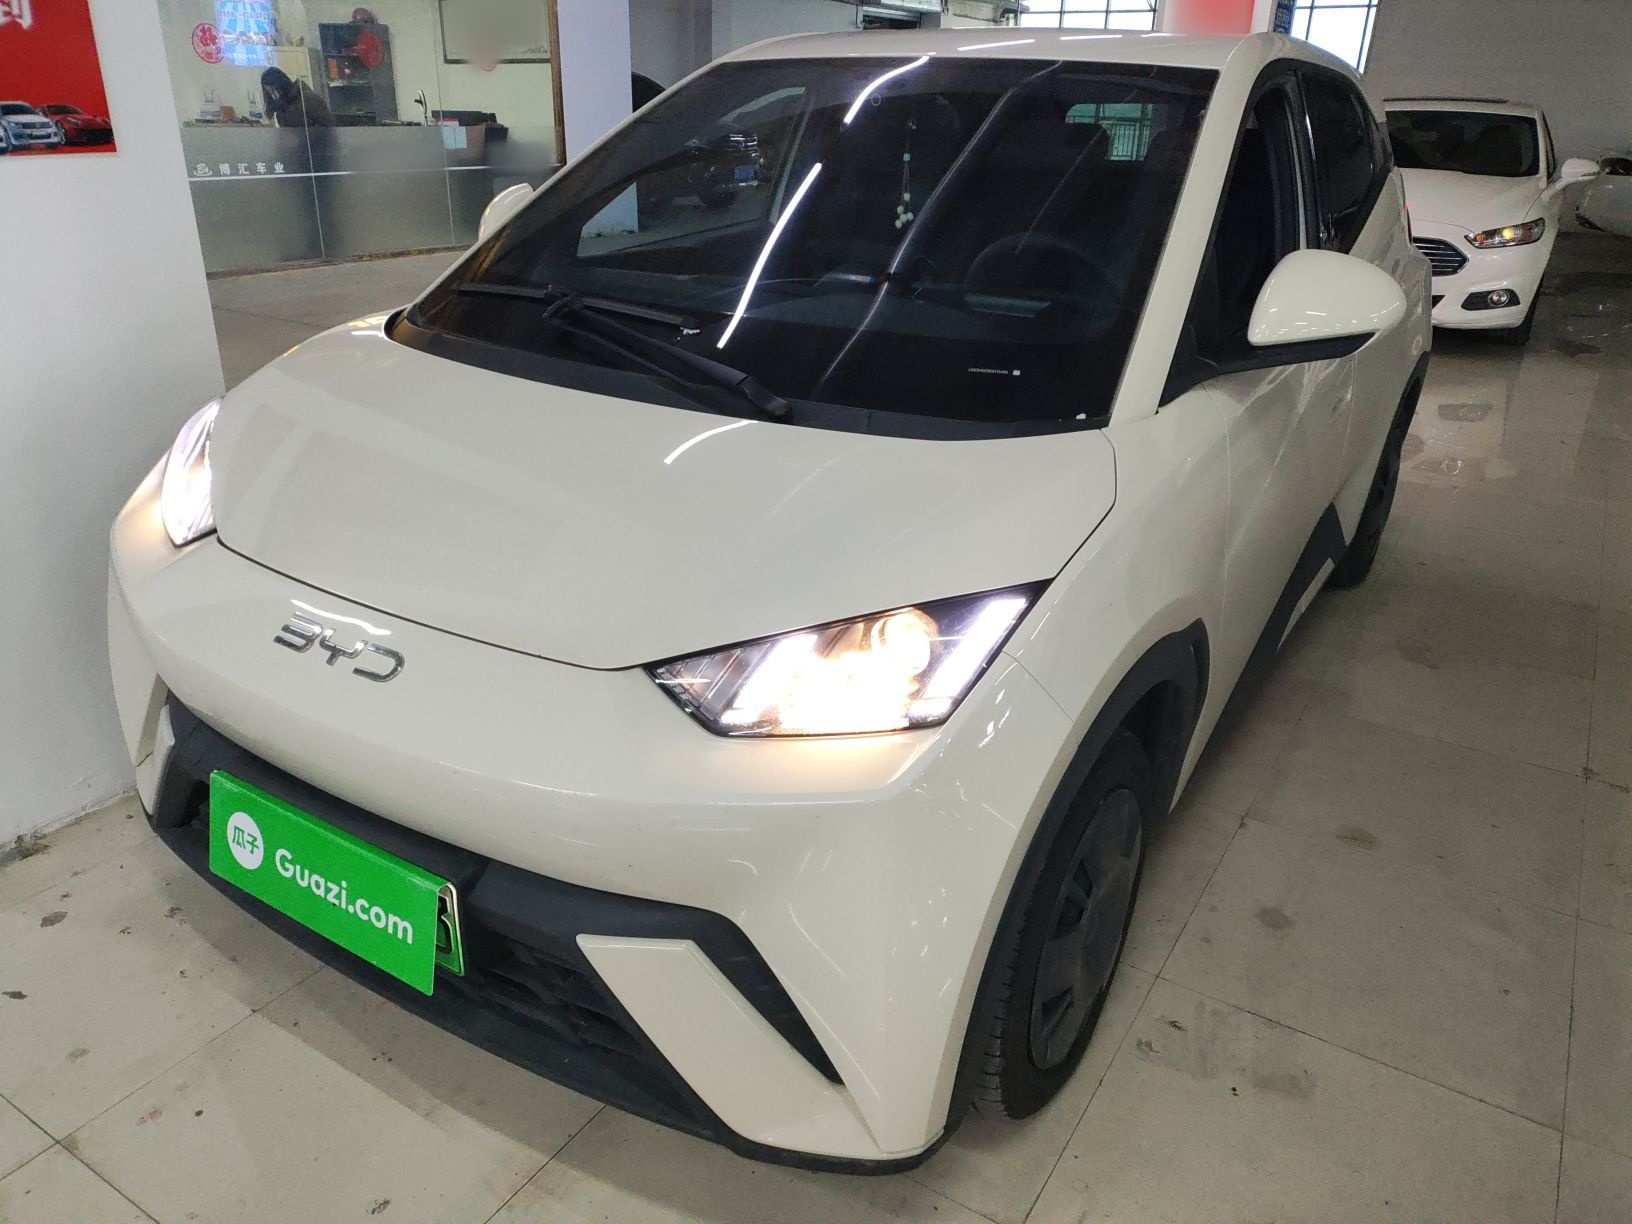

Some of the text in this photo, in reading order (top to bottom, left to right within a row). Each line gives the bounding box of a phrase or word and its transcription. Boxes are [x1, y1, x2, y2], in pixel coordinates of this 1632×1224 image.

[219, 162, 285, 175] 博汇车业
[273, 611, 405, 682] BYD
[230, 824, 261, 855] 瓜子
[274, 847, 414, 945] Guazi.com
